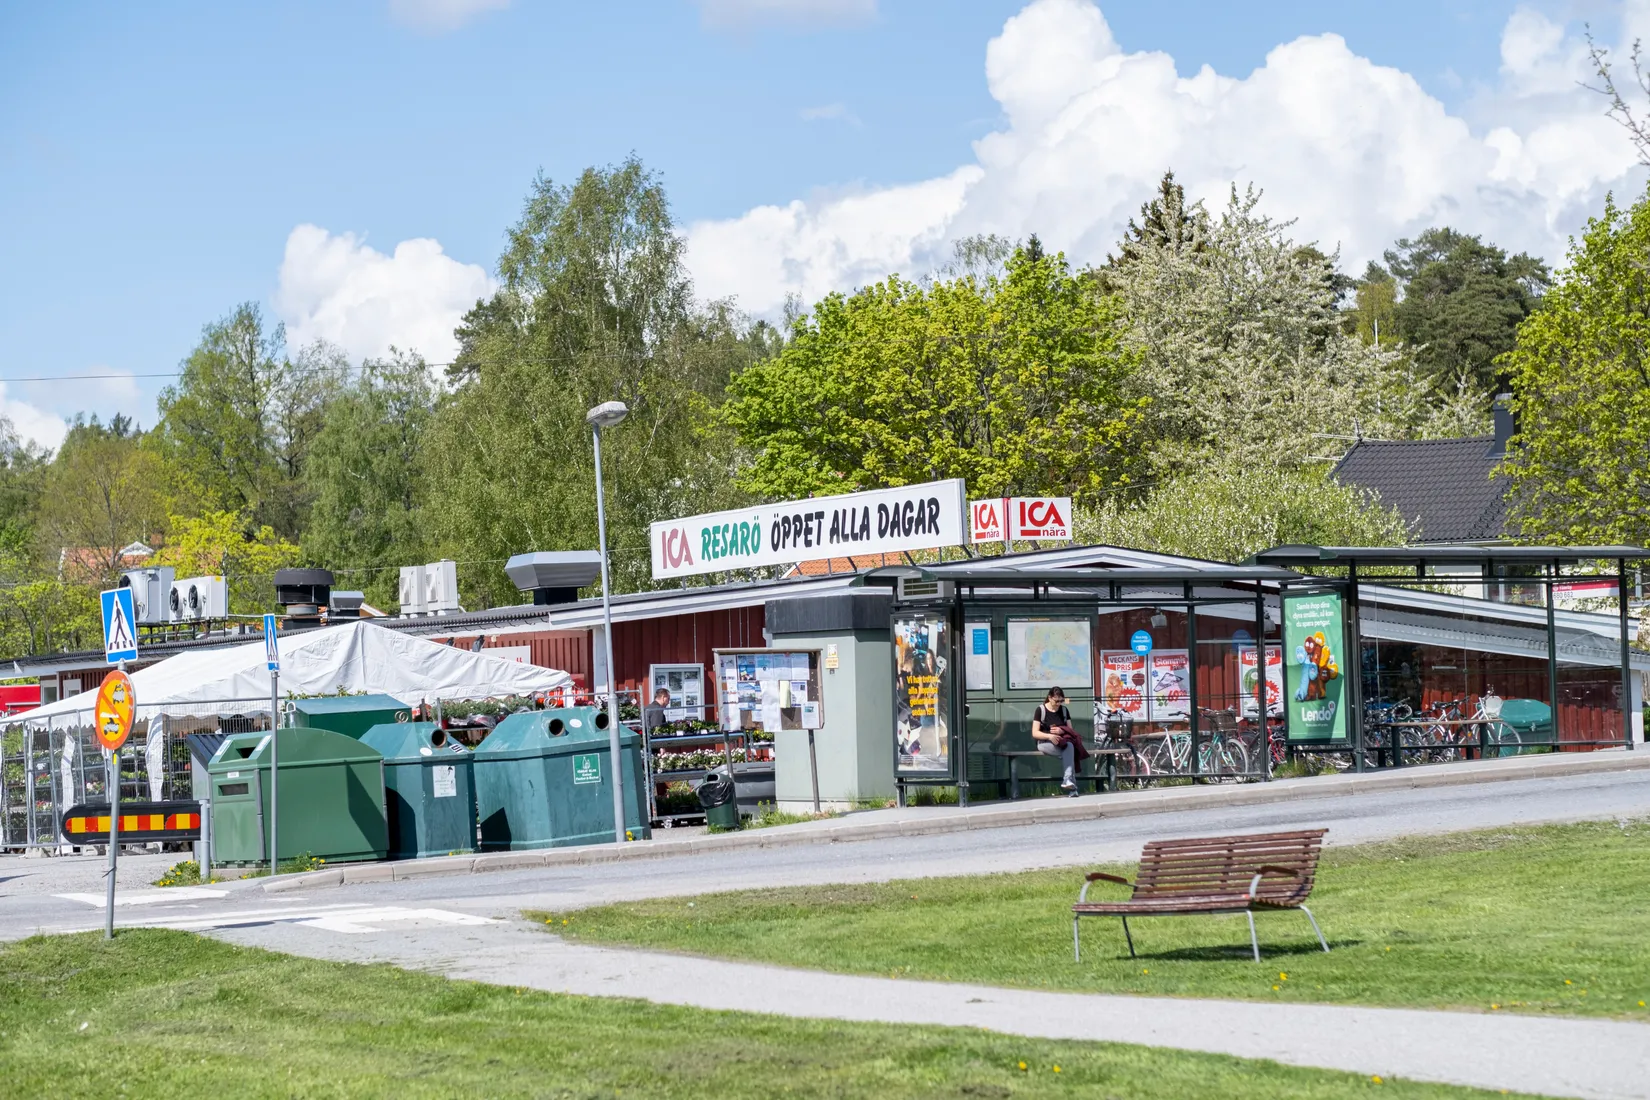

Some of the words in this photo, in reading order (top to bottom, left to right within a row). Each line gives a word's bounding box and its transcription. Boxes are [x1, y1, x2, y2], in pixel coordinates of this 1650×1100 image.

[974, 503, 999, 530] ICA
[1020, 501, 1065, 527] ICA
[662, 528, 693, 569] ICA
[701, 515, 761, 562] RESARÖ
[771, 513, 824, 552] ÖPPET
[829, 506, 870, 544] ALLA
[877, 497, 940, 539] DAGAR
[986, 529, 999, 538] nära
[1042, 527, 1066, 537] nära
[1109, 655, 1138, 664] VECKANS
[1301, 706, 1331, 721] Lendo
